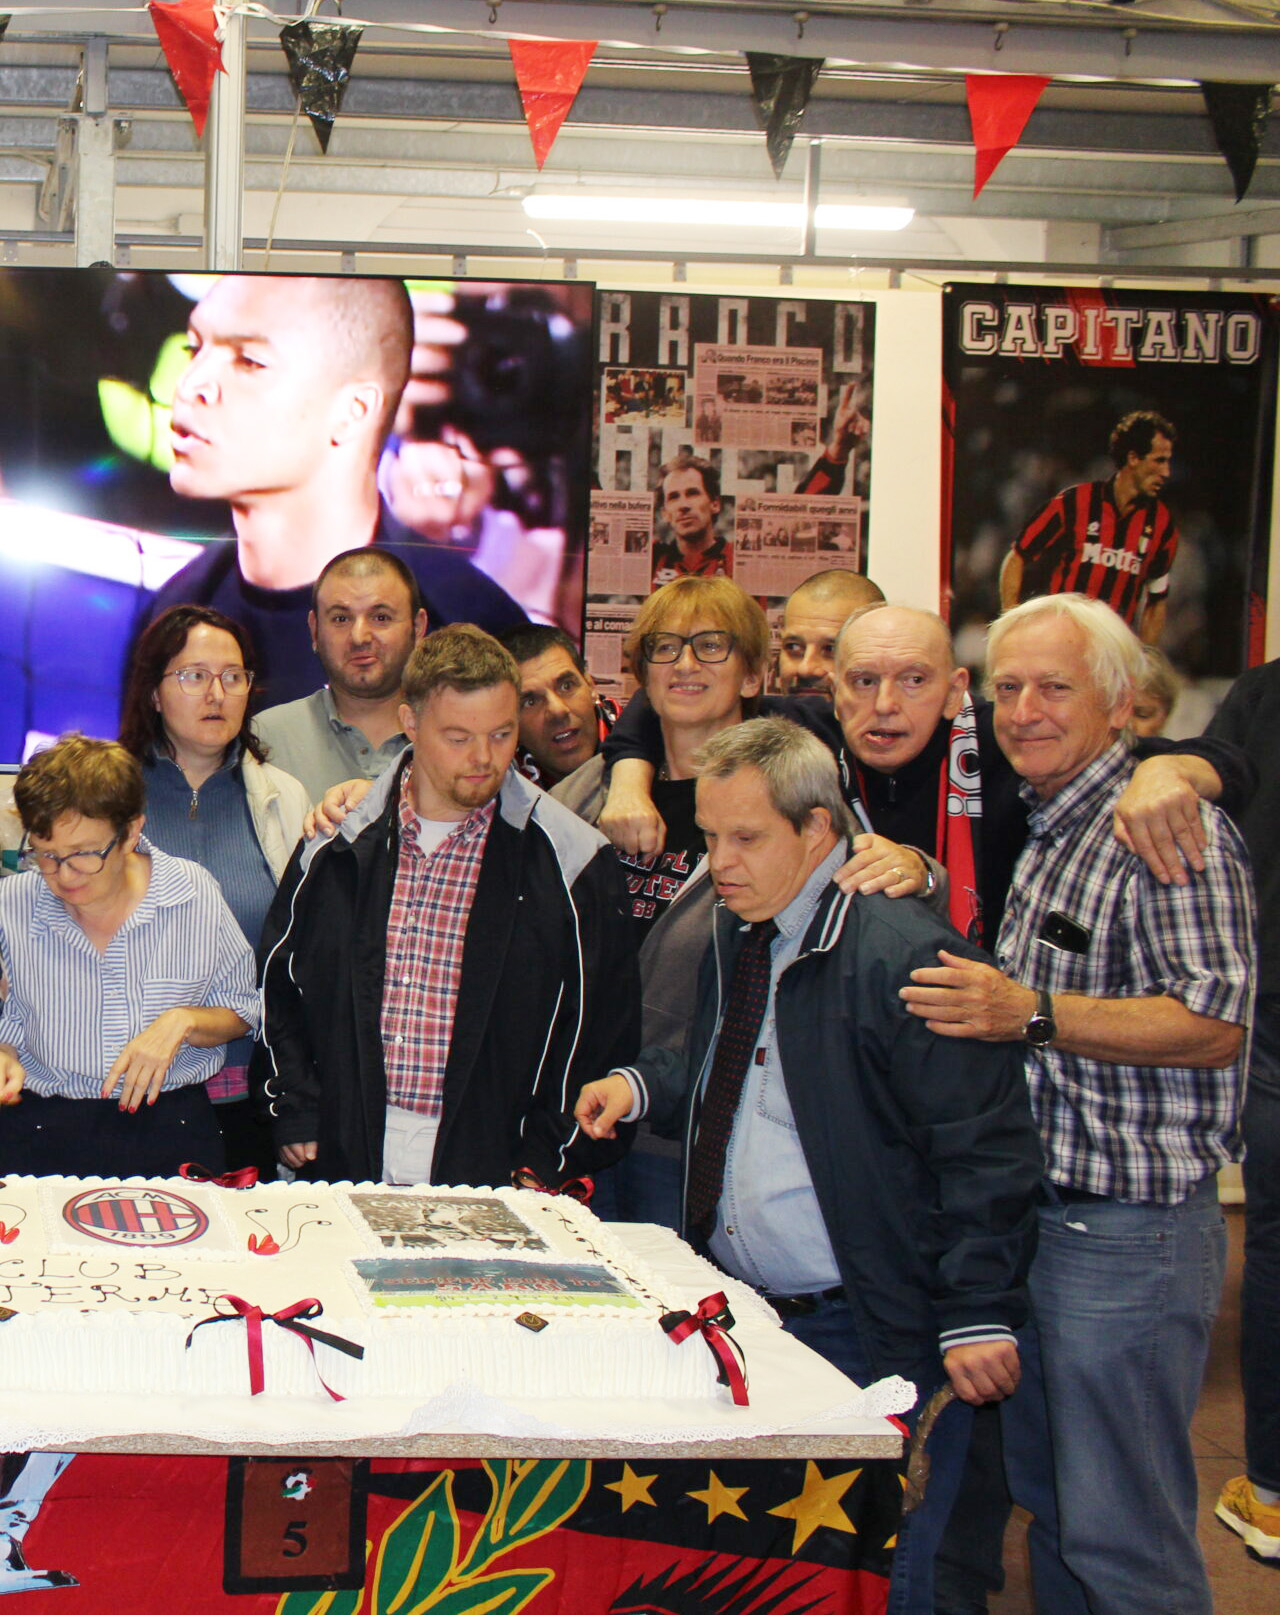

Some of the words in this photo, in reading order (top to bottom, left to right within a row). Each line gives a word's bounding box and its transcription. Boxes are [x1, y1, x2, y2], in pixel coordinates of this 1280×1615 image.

[960, 301, 1261, 365] CAPITANO
[92, 1190, 168, 1201] ACM
[109, 1231, 177, 1241] 1899
[282, 1521, 308, 1558] 5
